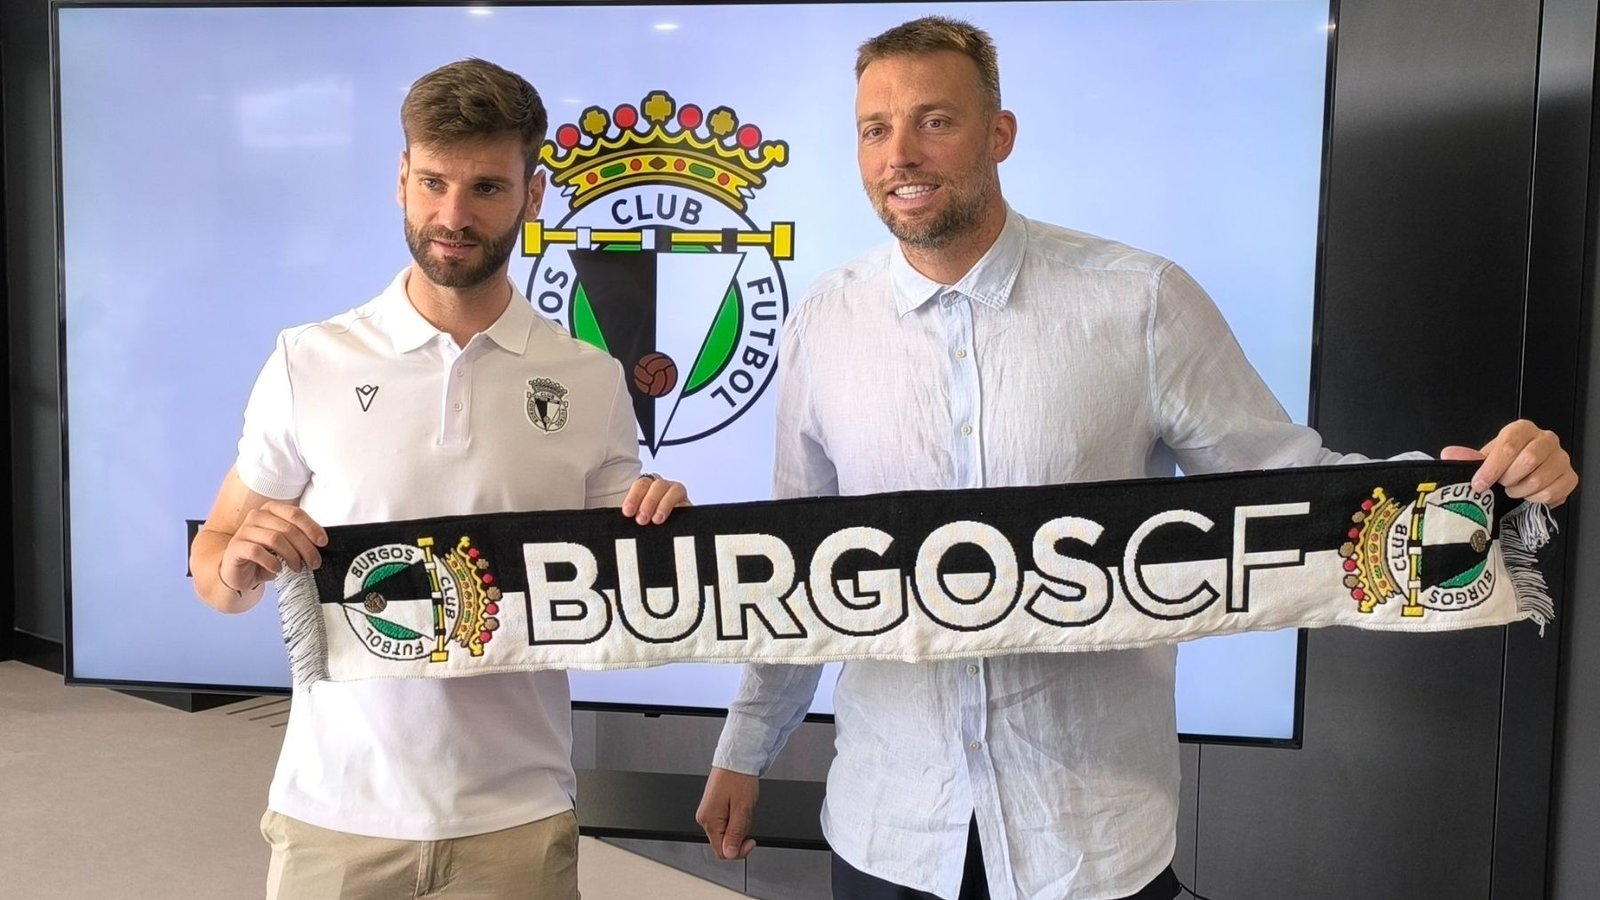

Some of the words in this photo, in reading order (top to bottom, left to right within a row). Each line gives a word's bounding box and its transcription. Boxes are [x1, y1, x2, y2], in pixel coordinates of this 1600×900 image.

[611, 193, 703, 225] CLUB
[711, 276, 777, 408] FUTBOL
[351, 547, 415, 579] BURGOS
[1392, 523, 1408, 571] CLUB
[440, 576, 456, 620] CLUB
[1428, 569, 1493, 604] BURGOS
[366, 627, 424, 656] FUTBOL
